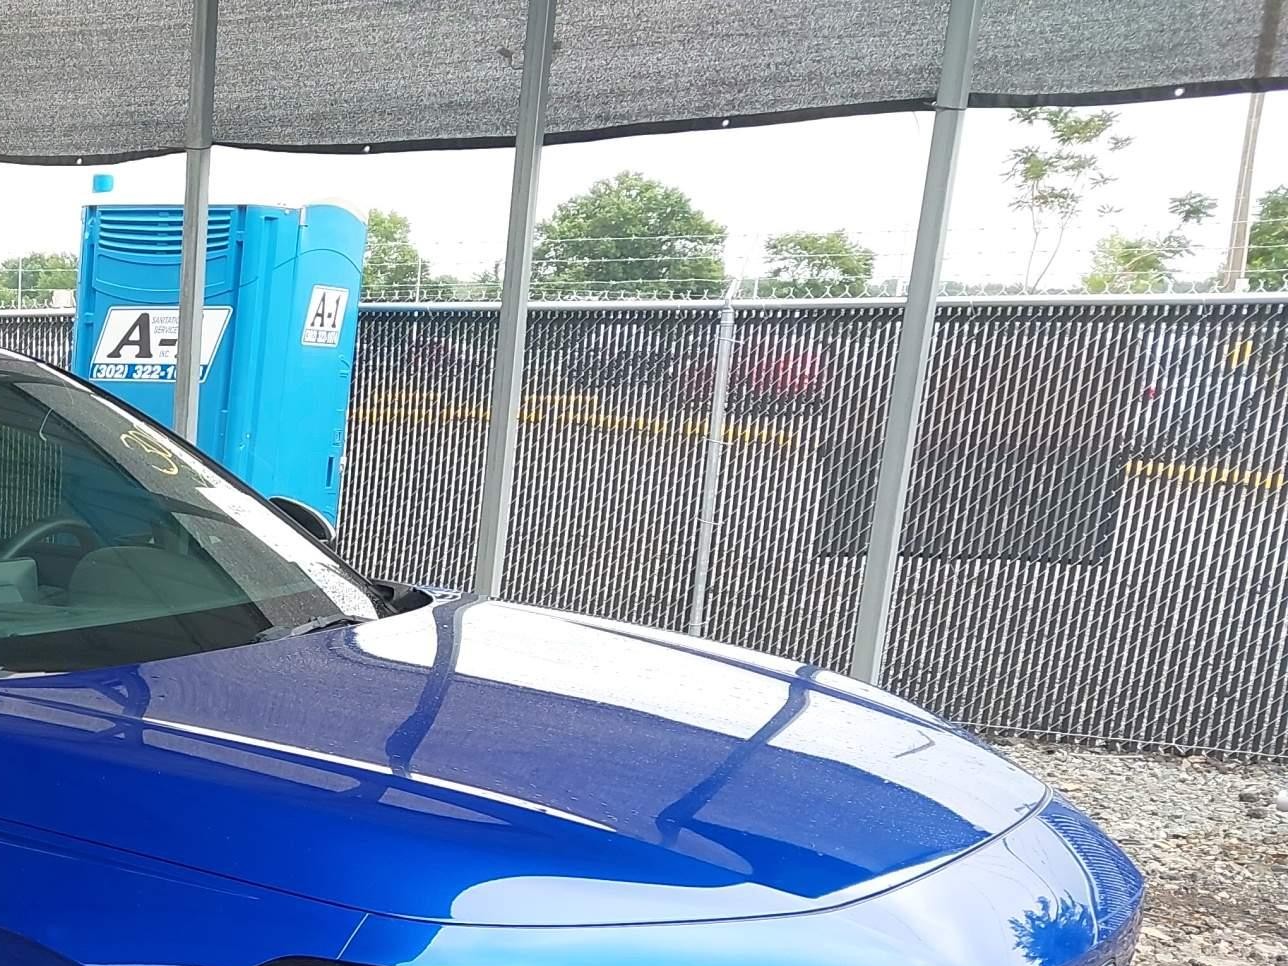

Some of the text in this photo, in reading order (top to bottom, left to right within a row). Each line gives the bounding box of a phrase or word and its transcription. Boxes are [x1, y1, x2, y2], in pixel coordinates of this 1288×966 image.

[310, 291, 341, 328] A-1
[106, 312, 179, 358] A-
[93, 364, 129, 378] (302)
